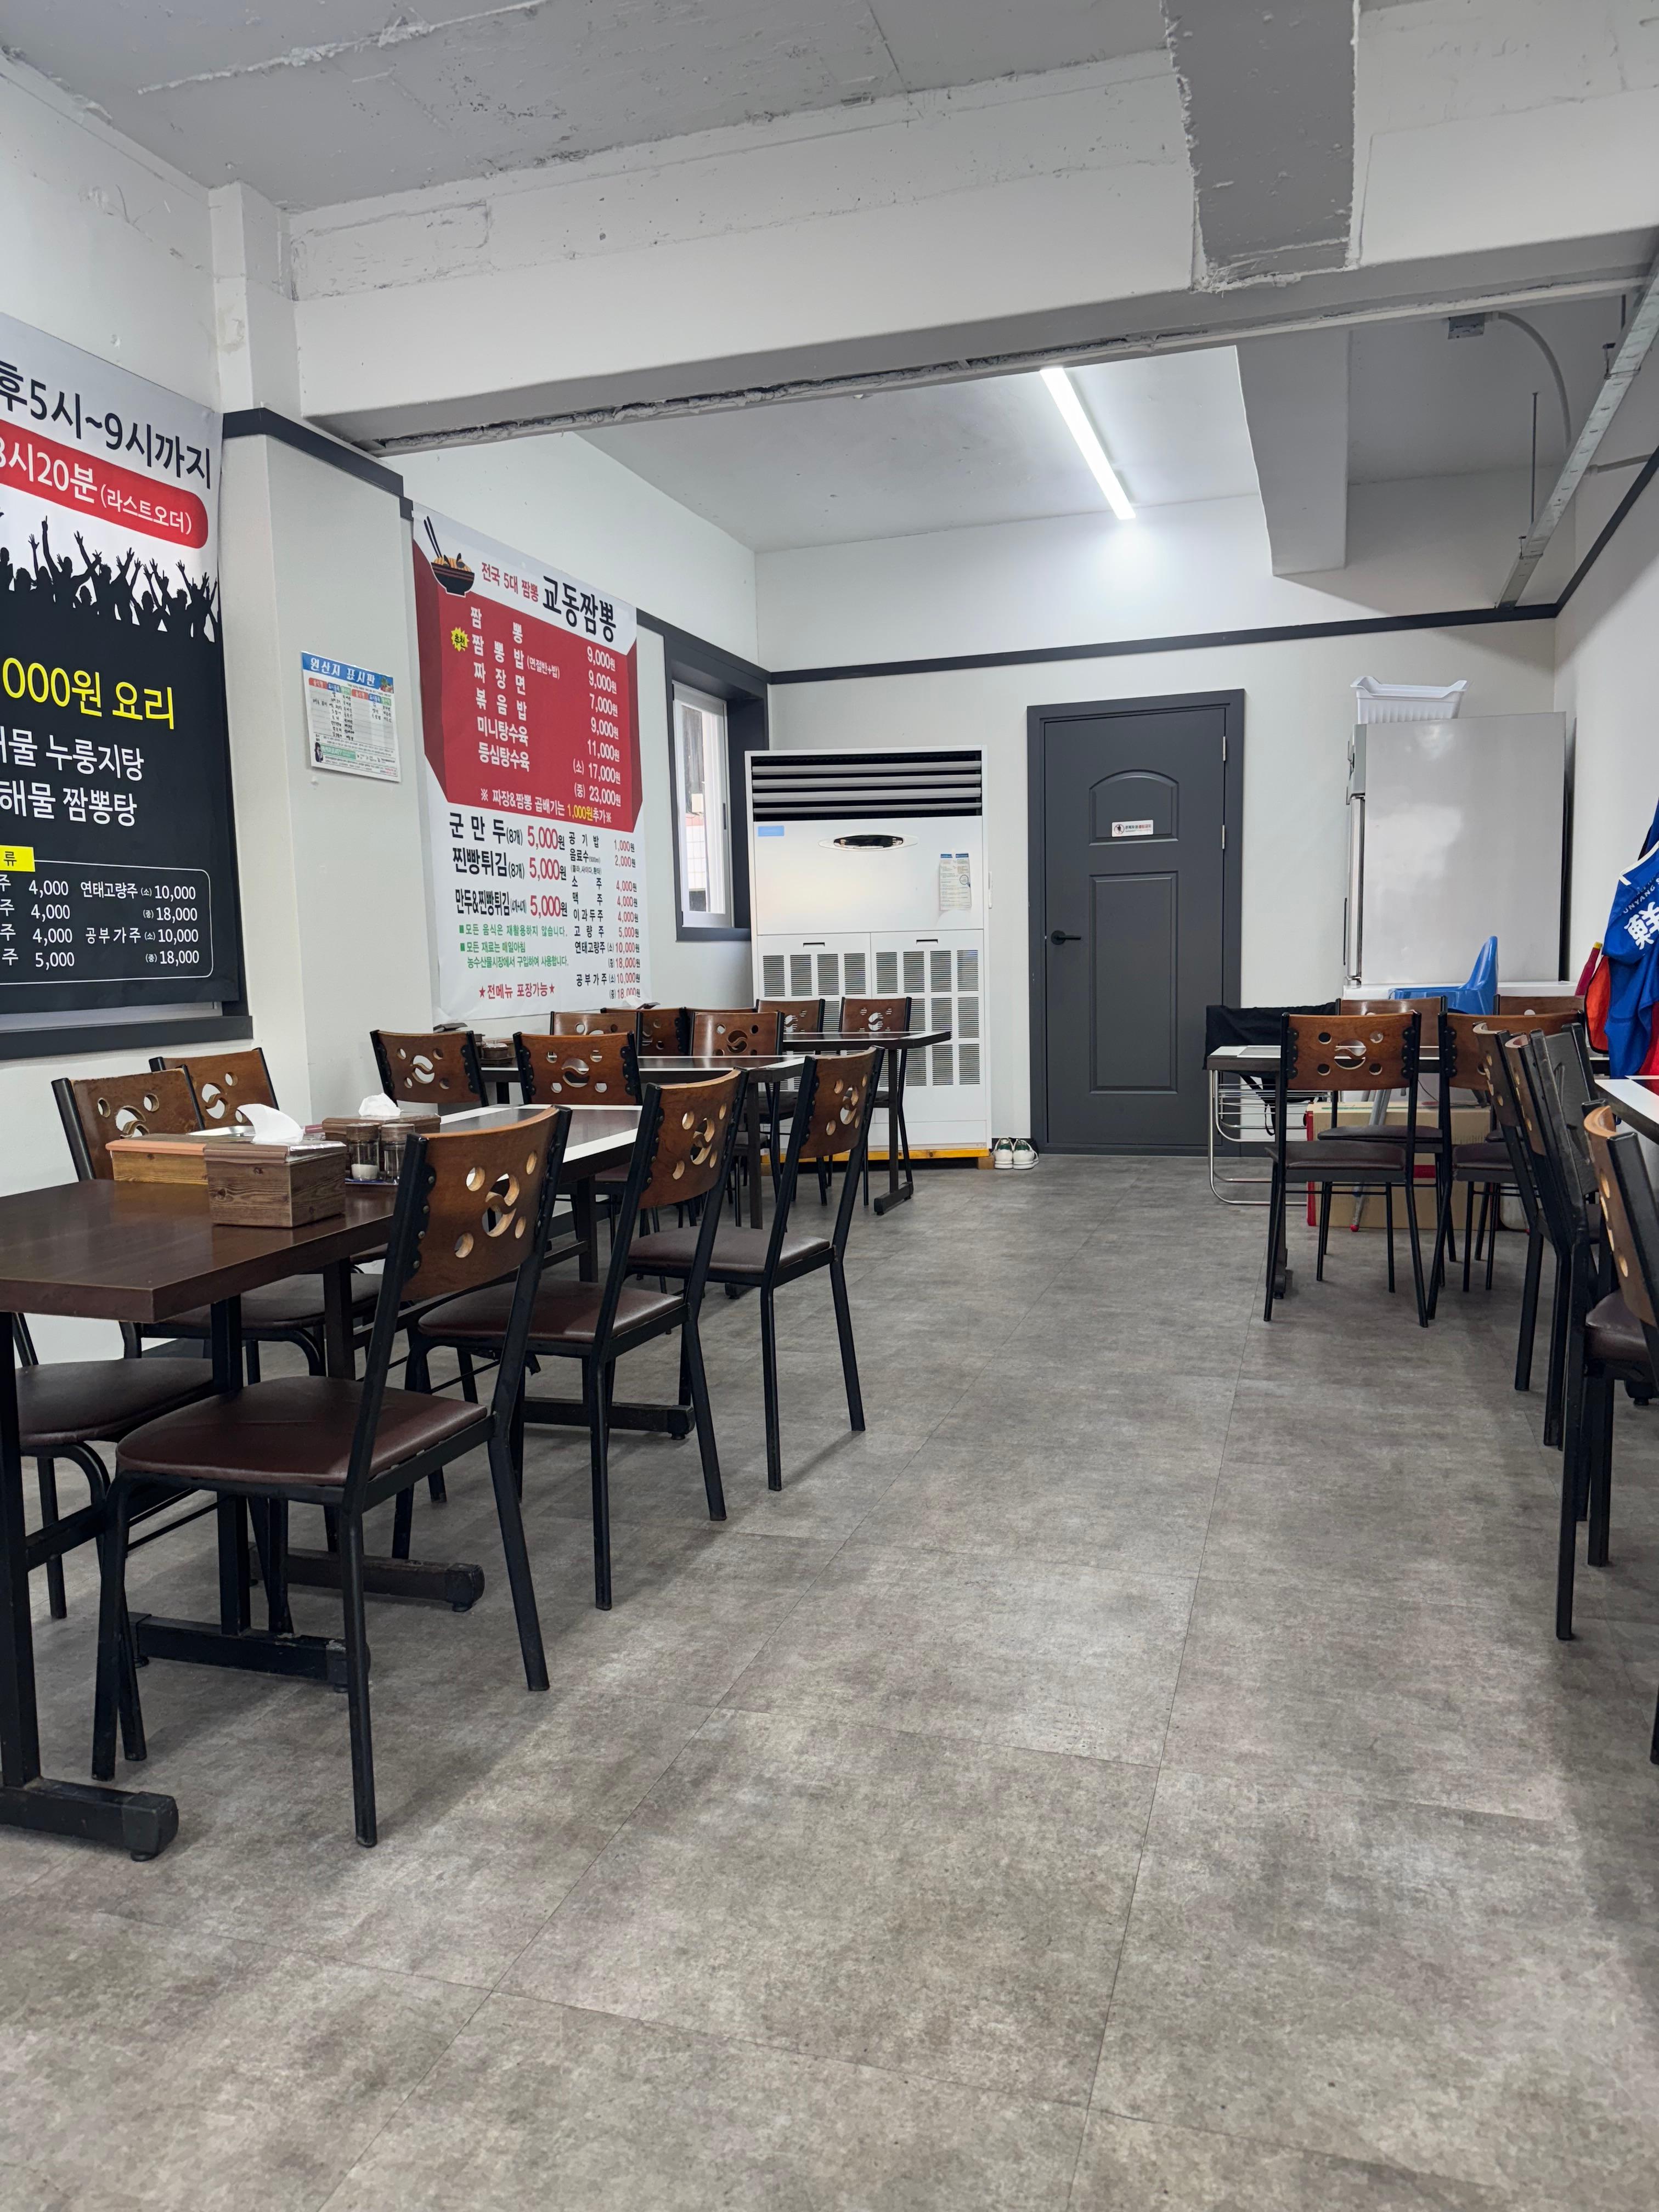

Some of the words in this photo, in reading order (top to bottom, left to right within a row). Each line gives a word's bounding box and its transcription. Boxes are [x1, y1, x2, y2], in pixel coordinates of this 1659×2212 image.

[101, 484, 192, 535] (라스트오더)
[481, 562, 500, 586] 전국
[504, 572, 518, 594] 5대
[521, 579, 539, 603] 짬뽕
[543, 575, 617, 643] 교동짬뽕
[454, 633, 466, 648] 추천
[586, 646, 616, 672] 9,000원
[311, 657, 340, 676] 원산지
[346, 667, 375, 686] 표시판
[588, 669, 617, 695] 9,000원
[112, 681, 174, 730] 요리
[589, 693, 618, 718] 7,000원
[591, 716, 619, 740] 9,000원
[477, 716, 529, 747] 미니탕수육
[587, 738, 620, 763] 11,000원
[0, 725, 38, 767] 물
[46, 734, 144, 781] 누룽지탕
[478, 741, 530, 772] 등심탕수육
[573, 758, 584, 775] (소)
[588, 762, 621, 785] 17,000원
[0, 780, 56, 819] 해물
[63, 787, 137, 827] 짬뽕탕
[492, 789, 533, 811] 짜장&짬뽕
[534, 796, 565, 816] 곱배기는
[574, 782, 585, 799] (중)
[589, 785, 622, 807] 23,000원
[527, 825, 565, 850] 5,000원
[614, 839, 635, 853] 1,000원
[3, 851, 17, 866] 류
[614, 855, 636, 868] 2,000원
[529, 857, 567, 882] 5,000원
[29, 880, 69, 899] 4,000
[80, 881, 138, 899] 연태고량주
[140, 887, 152, 897] (소)
[154, 885, 196, 902] 10,000
[616, 880, 637, 893] 4,000원
[530, 895, 568, 919] 5,000원
[617, 895, 638, 907] 4,000원
[31, 904, 70, 922] 4,000
[156, 907, 198, 923] 18,000
[618, 911, 639, 923] 4,000원
[32, 928, 72, 946] 4,000
[144, 931, 156, 941] (소)
[157, 928, 199, 945] 10,000
[465, 924, 479, 935] 모든
[482, 924, 503, 936] 음식은
[506, 924, 538, 937] 재활용하지
[541, 926, 568, 937] 않습니다.
[618, 927, 639, 938] 5,000원
[466, 941, 479, 953] 모든
[482, 941, 500, 953] 재료는
[502, 941, 526, 953] 매일아침
[574, 941, 606, 954] 연태고량주
[616, 942, 640, 955] 10,000원
[35, 952, 75, 970] 5,000
[159, 950, 199, 967] 18,000
[467, 956, 515, 969] 농수산물시장에서
[517, 956, 539, 967] 구입하여
[541, 955, 569, 967] 사용합니다.
[616, 957, 640, 969] 18,000원
[617, 973, 640, 985] 10,000원
[487, 984, 513, 1000] 전메뉴
[517, 982, 548, 997] 포장가능
